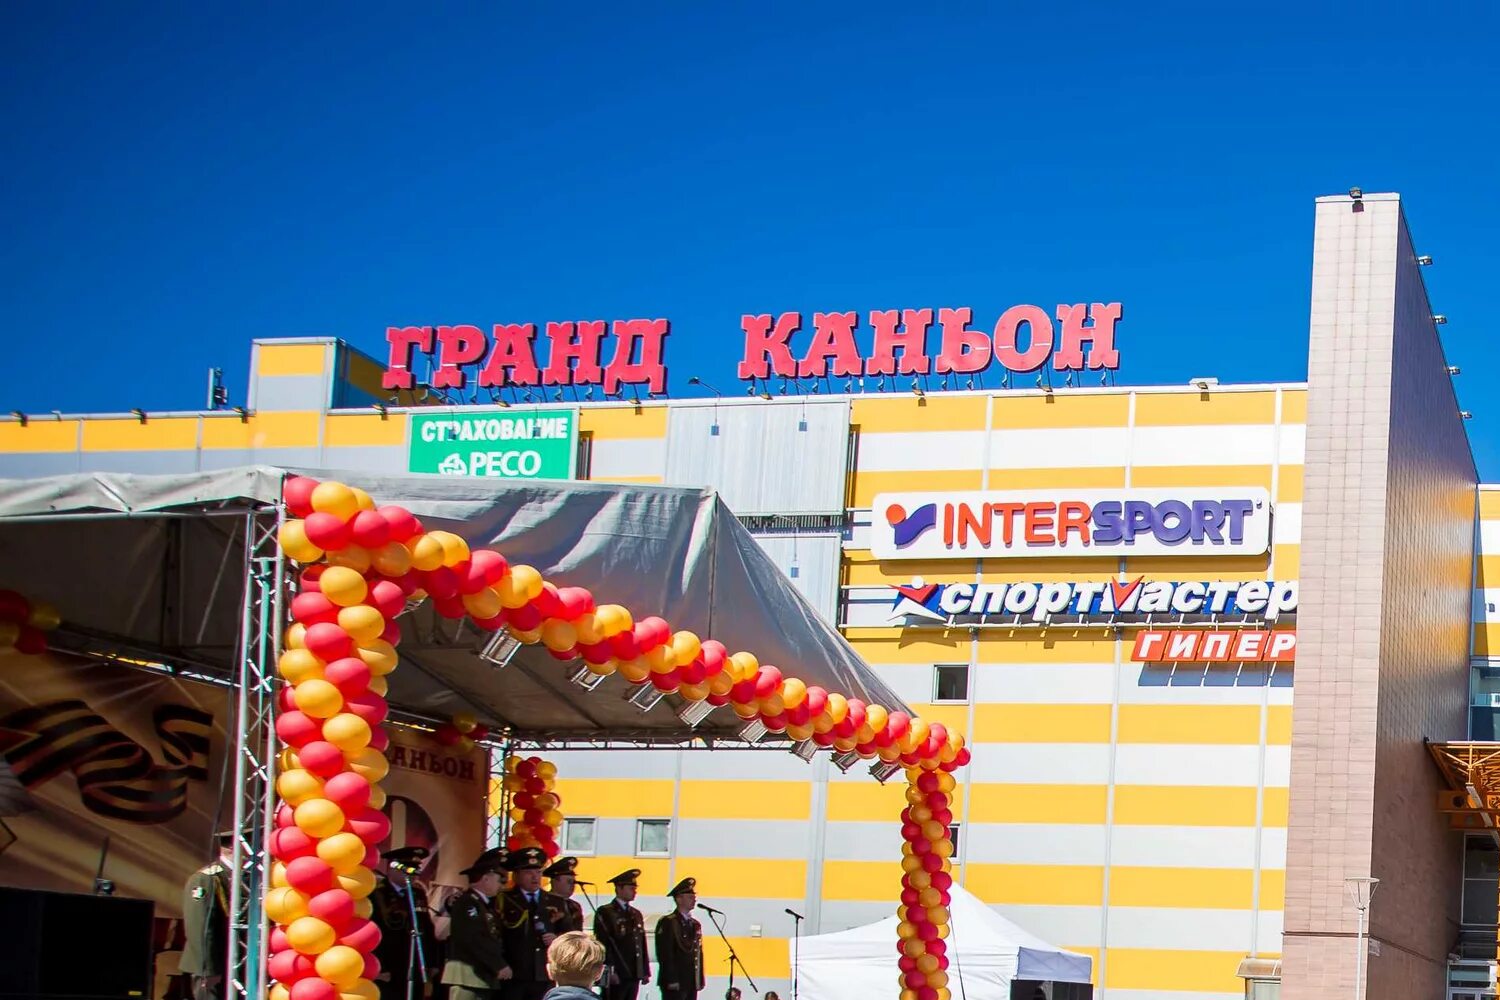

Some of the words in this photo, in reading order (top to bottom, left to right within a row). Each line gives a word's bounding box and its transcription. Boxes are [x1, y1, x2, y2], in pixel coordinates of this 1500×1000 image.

[382, 319, 670, 396] ГРАНД
[738, 302, 1123, 380] КАНЬОН
[470, 450, 542, 477] РЕСО
[943, 499, 1254, 547] INTERSPORT
[1138, 633, 1296, 658] ГИПЕР
[388, 746, 475, 781] АНЬОН
